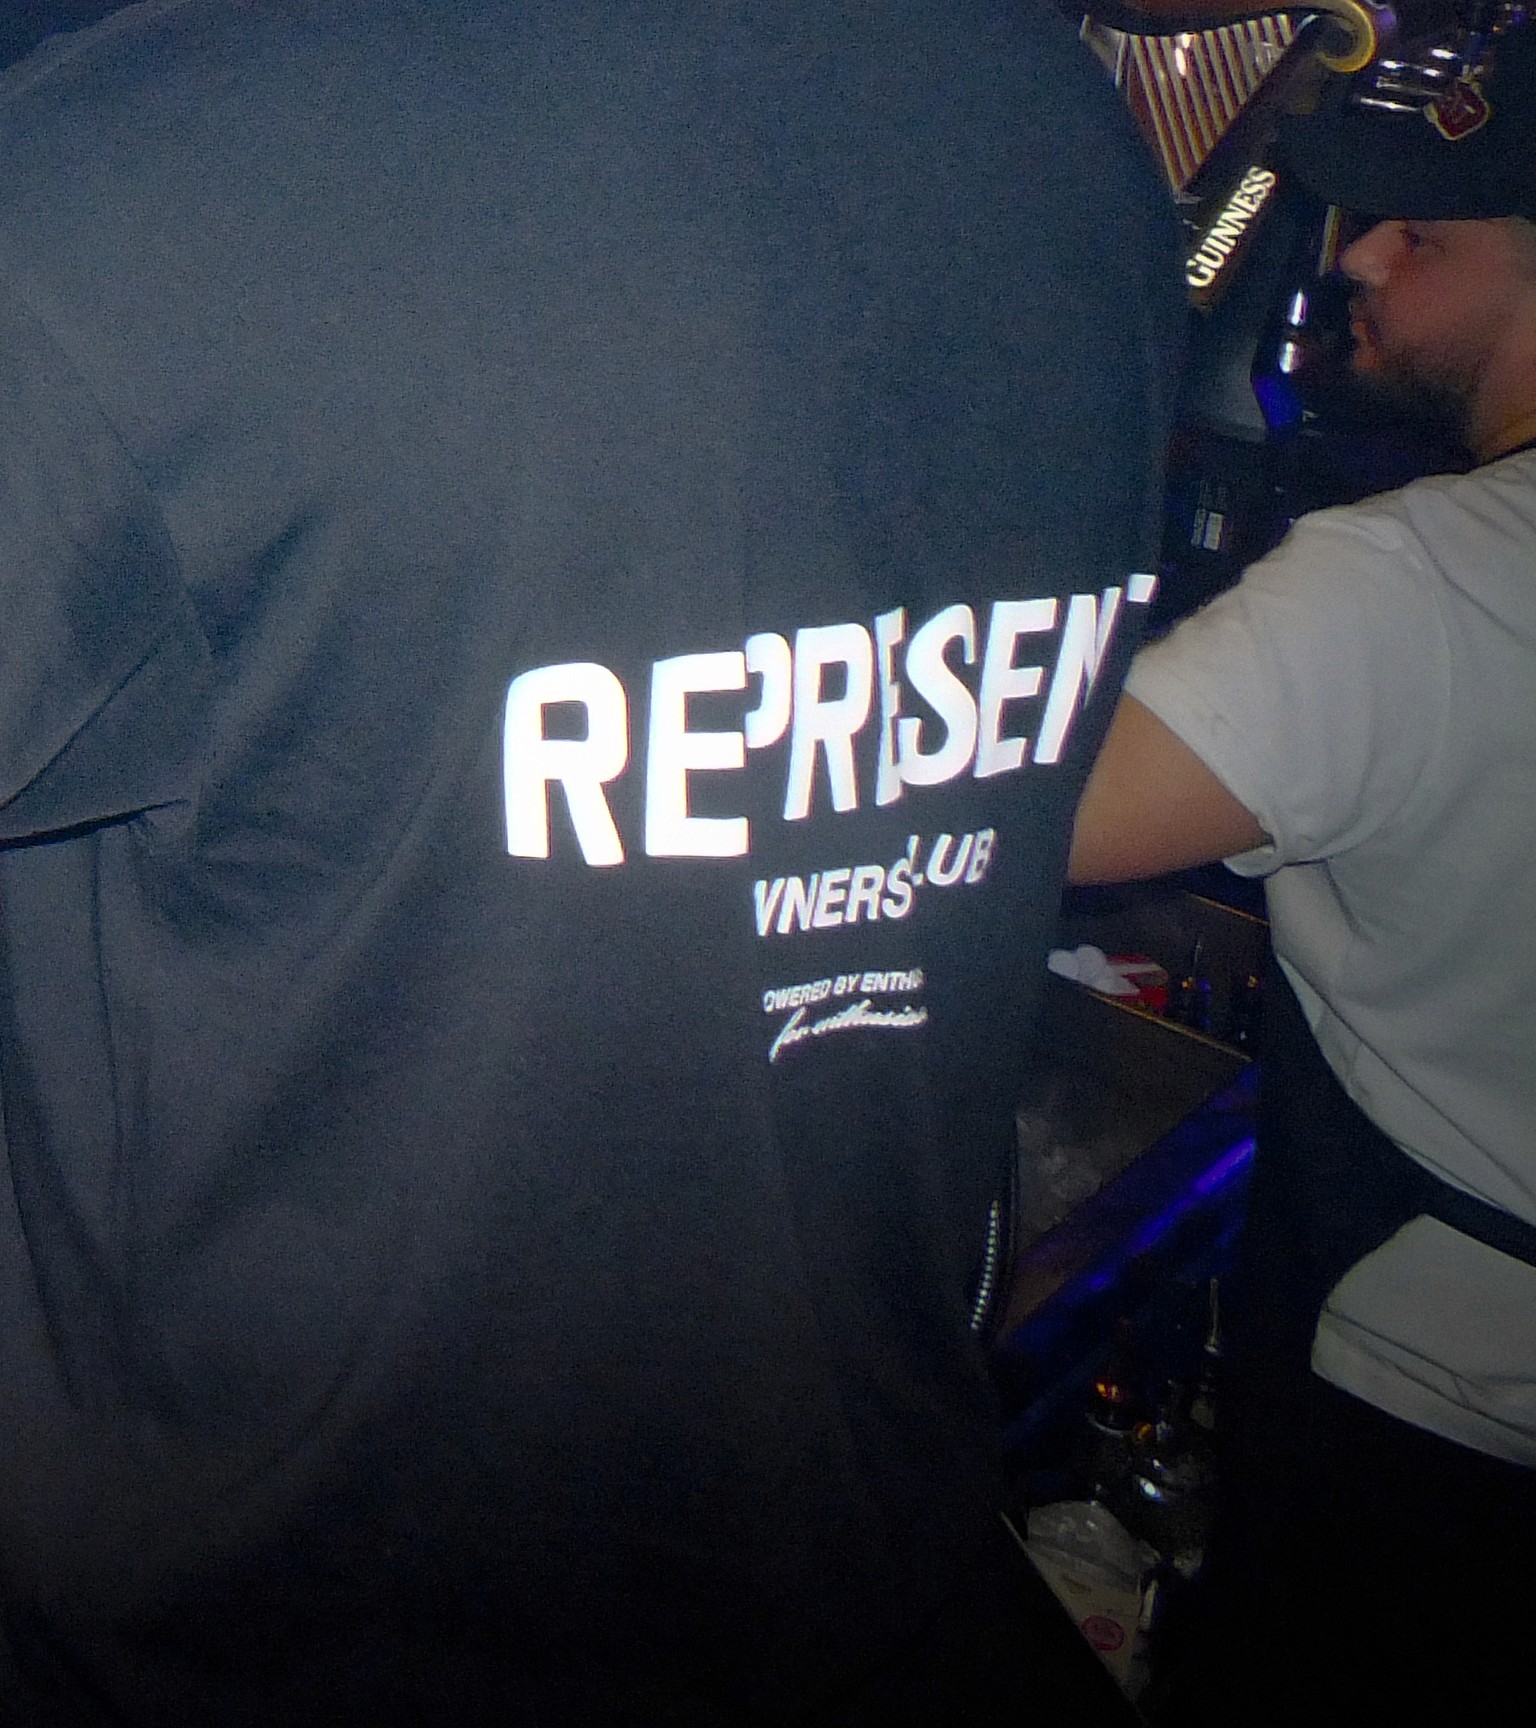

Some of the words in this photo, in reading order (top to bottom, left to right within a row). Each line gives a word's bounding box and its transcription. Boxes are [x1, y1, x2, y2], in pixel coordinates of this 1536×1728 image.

[1185, 165, 1276, 287] GUINNESS
[502, 573, 1157, 868] REPRESEN
[762, 979, 833, 1013] OWERED
